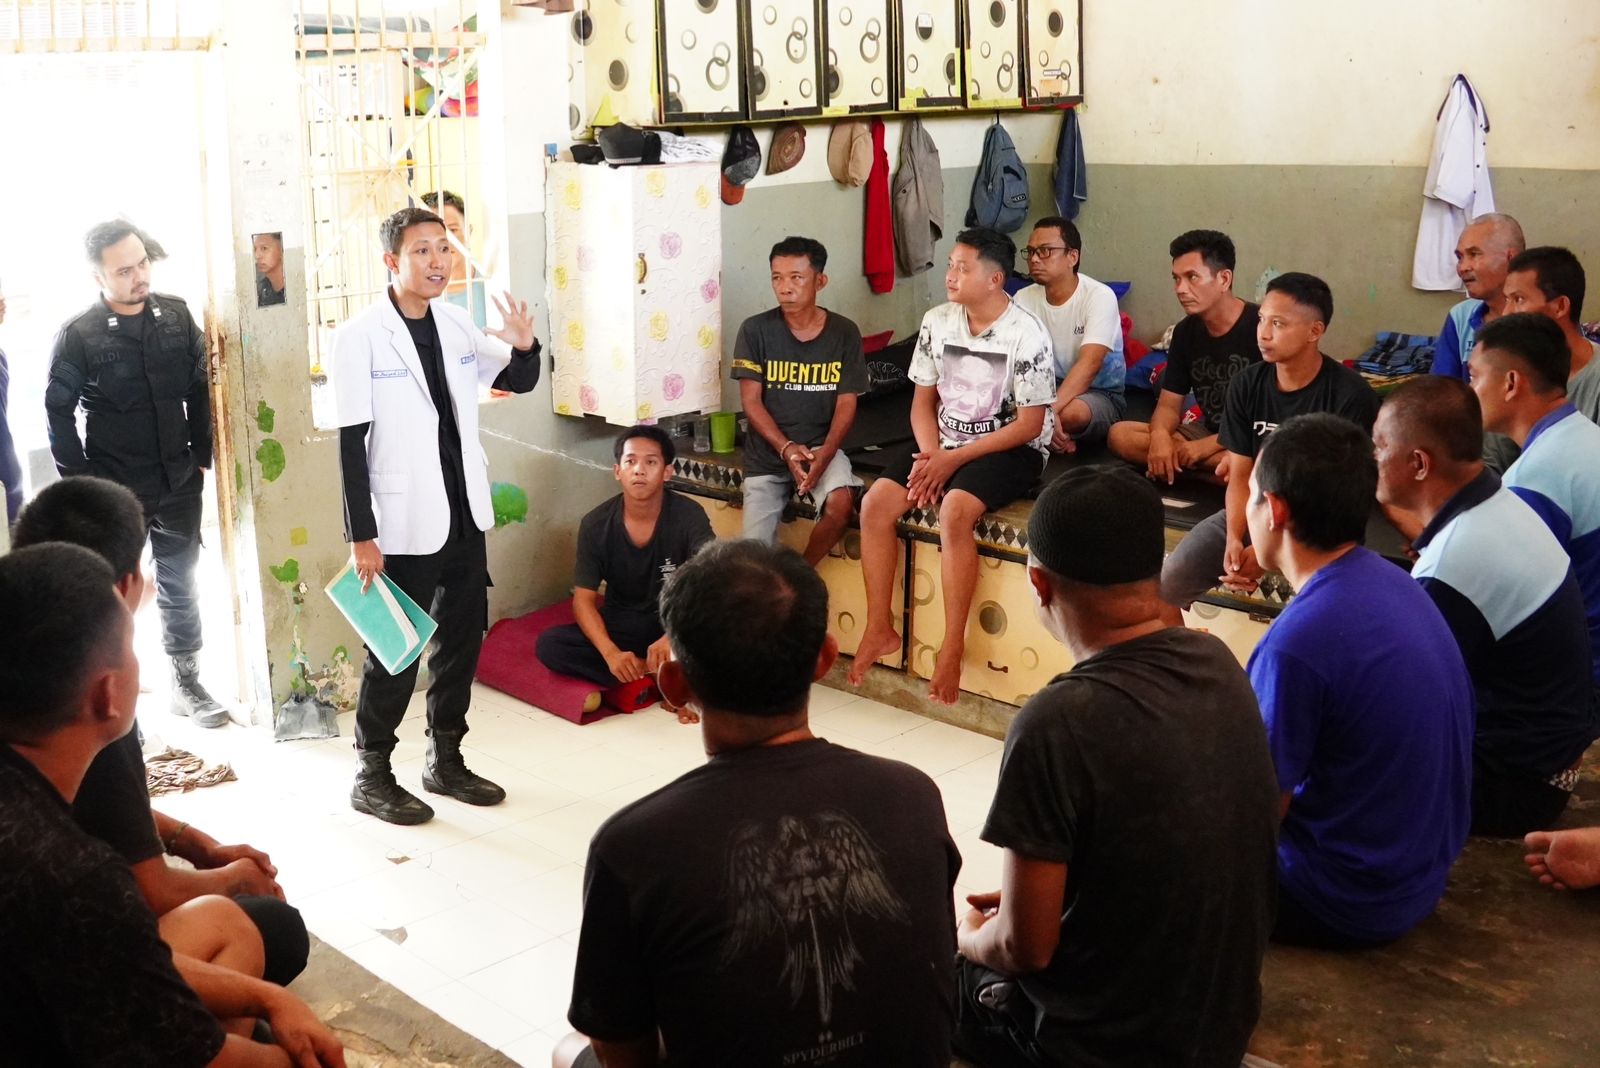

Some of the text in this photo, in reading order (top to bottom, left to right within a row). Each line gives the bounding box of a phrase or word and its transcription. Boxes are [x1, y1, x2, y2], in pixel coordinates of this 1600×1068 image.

[765, 360, 842, 384] UVENTUS
[784, 382, 837, 392] CLUB INDONESIA
[958, 422, 973, 433] AZZ
[974, 422, 991, 433] CUT
